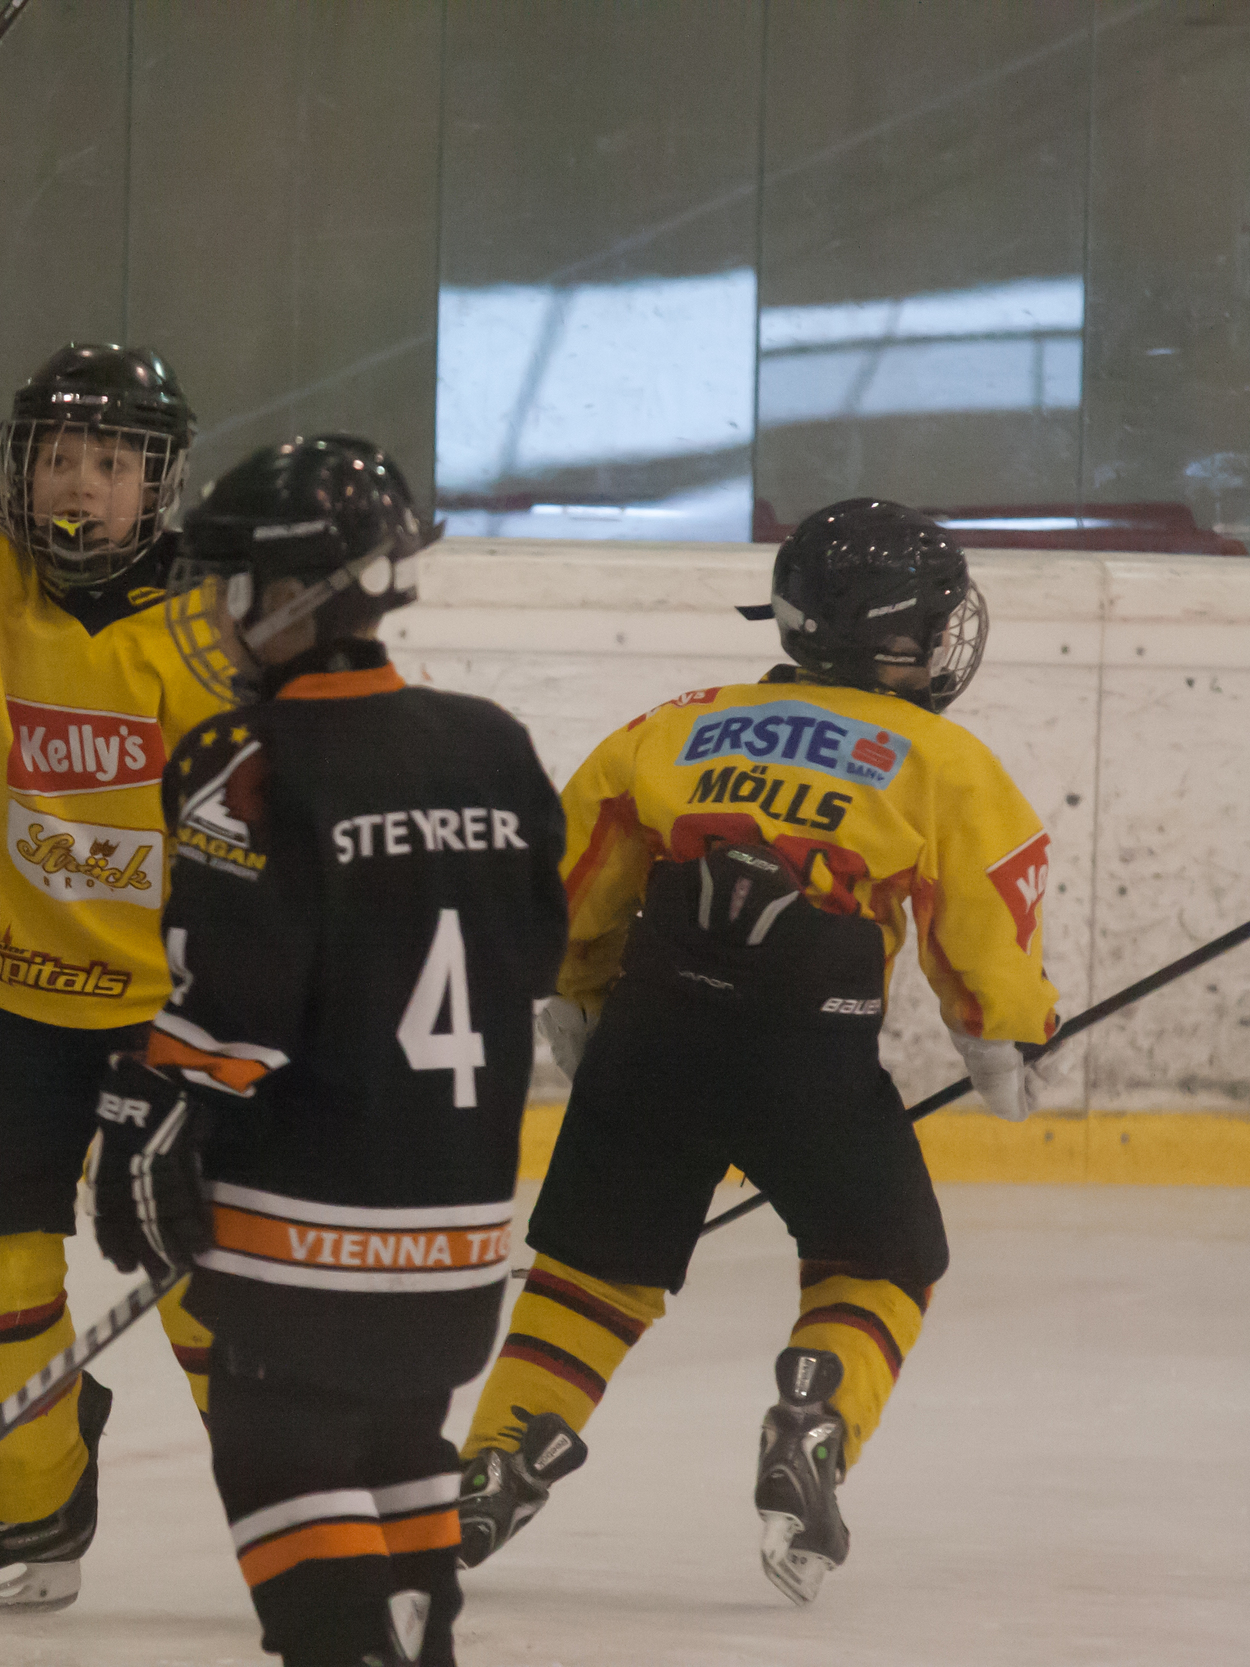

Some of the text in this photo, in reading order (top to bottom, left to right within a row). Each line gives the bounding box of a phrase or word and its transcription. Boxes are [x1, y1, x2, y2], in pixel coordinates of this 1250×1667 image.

[19, 724, 147, 782] Kelly's
[684, 715, 849, 769] ERSTE
[687, 765, 854, 832] MÖLLS
[332, 807, 529, 864] STEYRER
[396, 908, 487, 1108] 4
[820, 996, 882, 1016] BAUE
[288, 1226, 452, 1268] VIENNA
